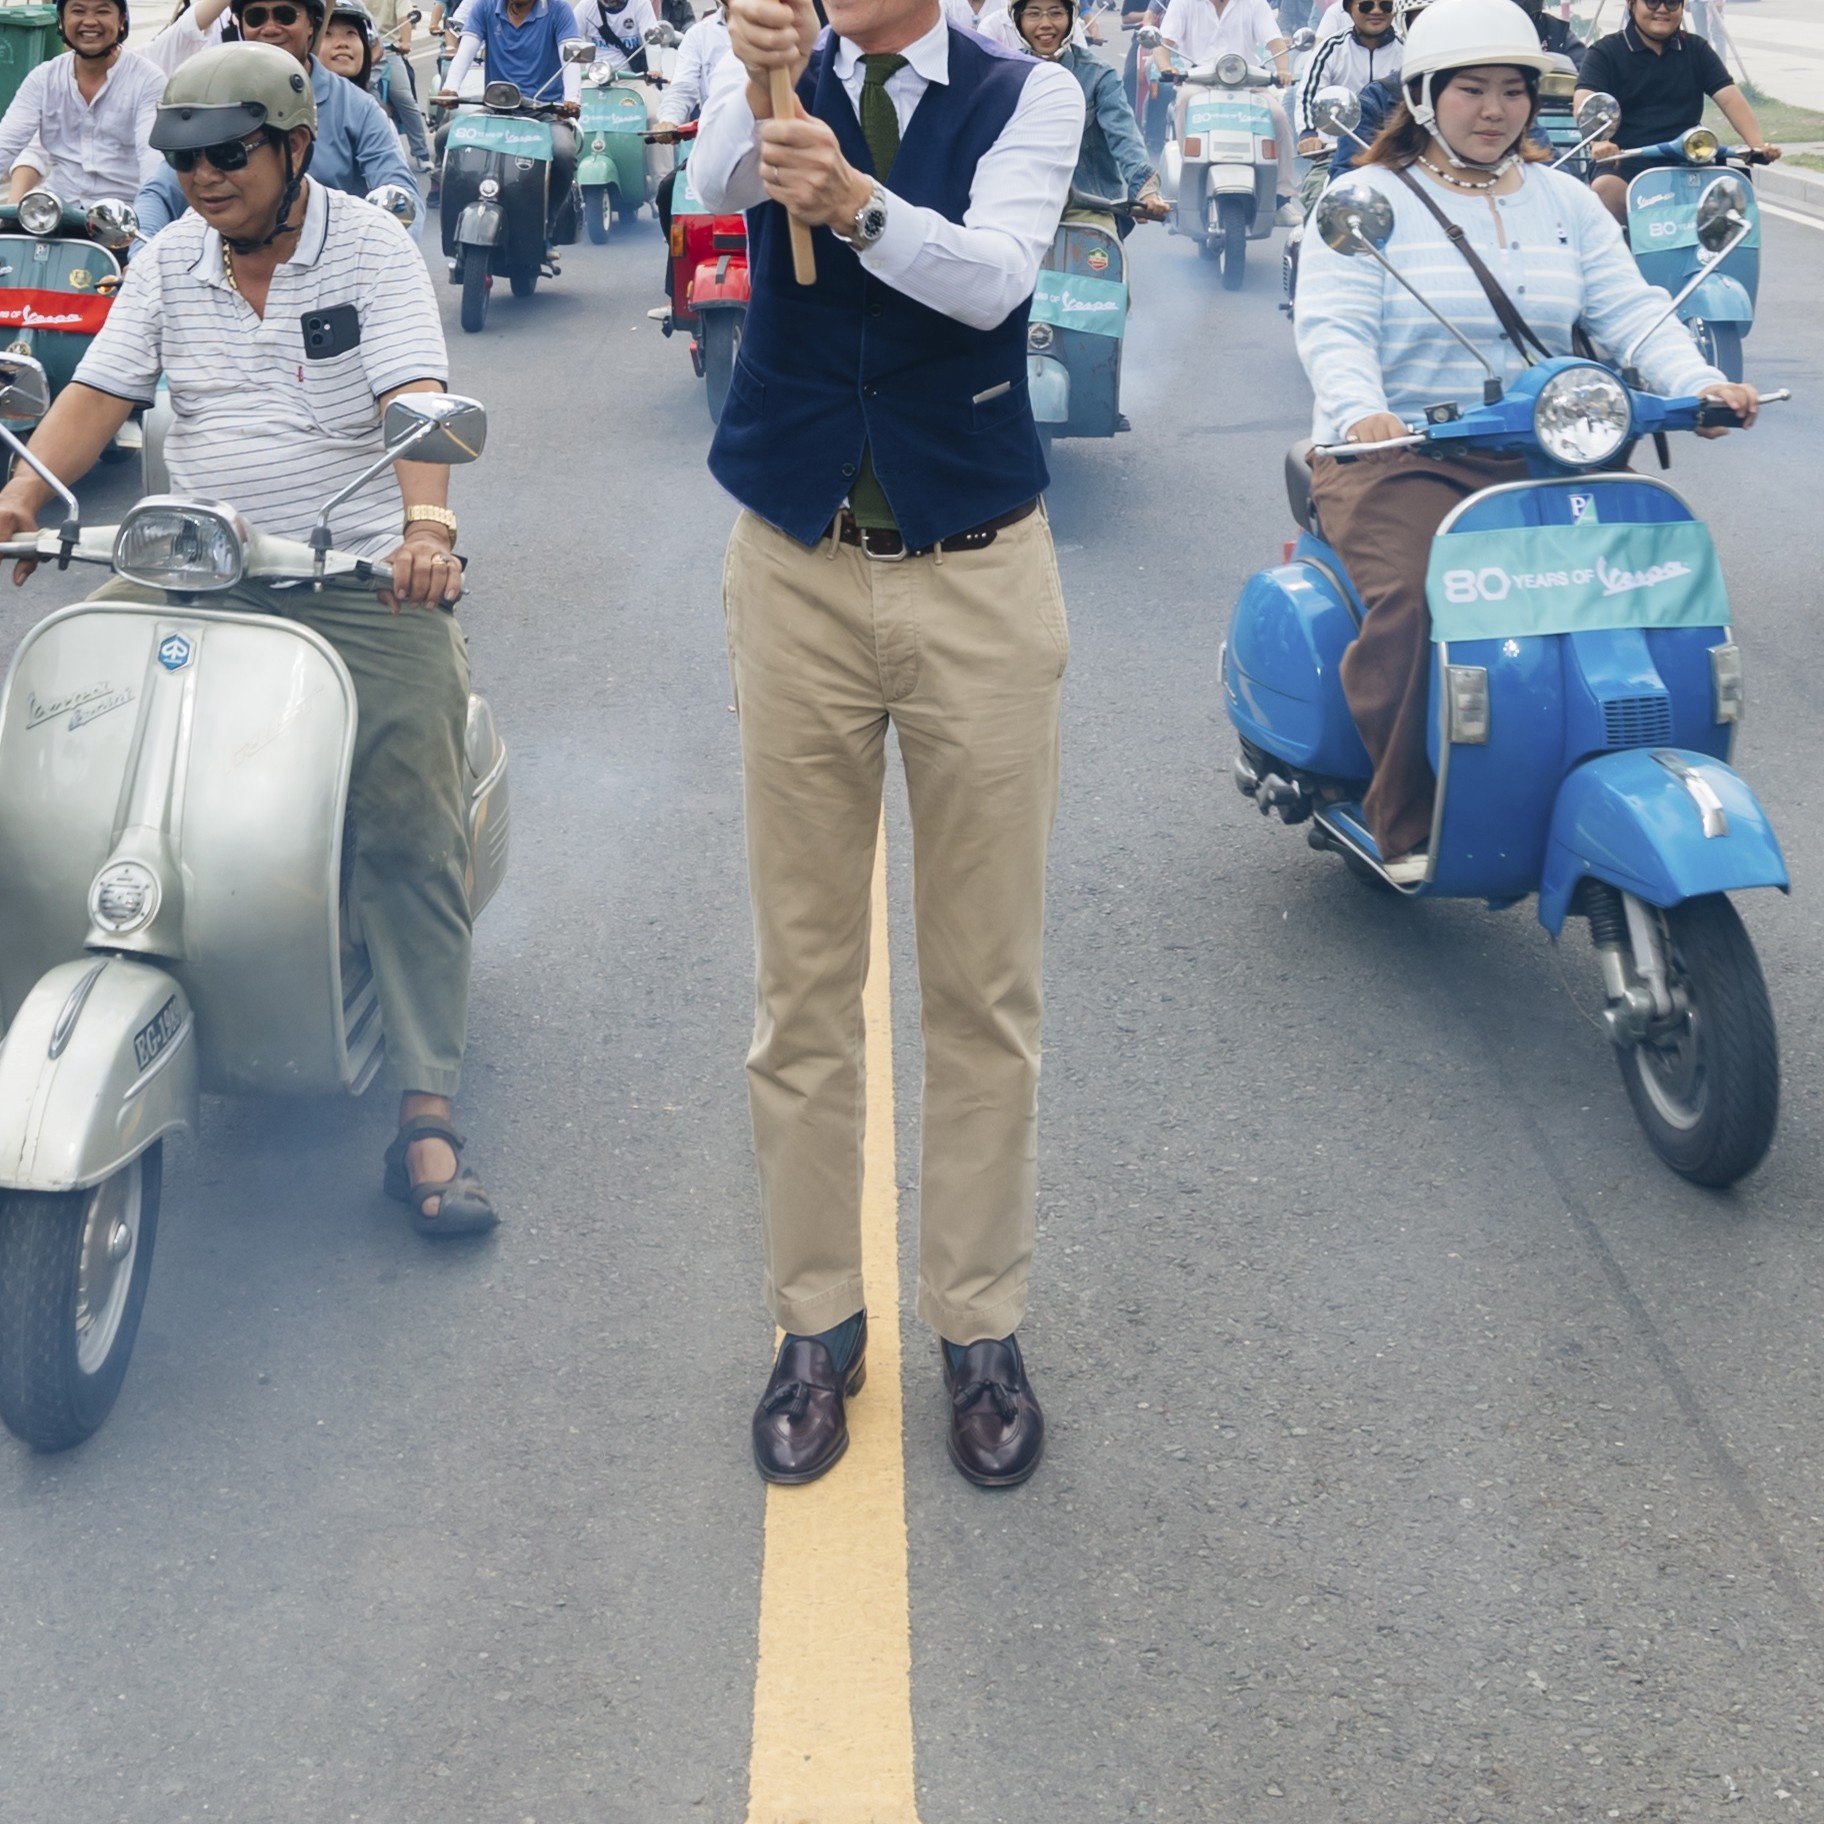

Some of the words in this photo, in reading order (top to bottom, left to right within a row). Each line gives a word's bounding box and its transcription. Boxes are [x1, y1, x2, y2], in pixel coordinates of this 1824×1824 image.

[455, 127, 477, 140] 80
[1649, 221, 1677, 237] 80
[1062, 290, 1119, 312] Vespa
[22, 304, 82, 325] Vespa
[1443, 567, 1511, 603] 80
[1513, 572, 1569, 589] YEARS
[1571, 569, 1595, 584] OF
[1596, 556, 1691, 597] Vespa
